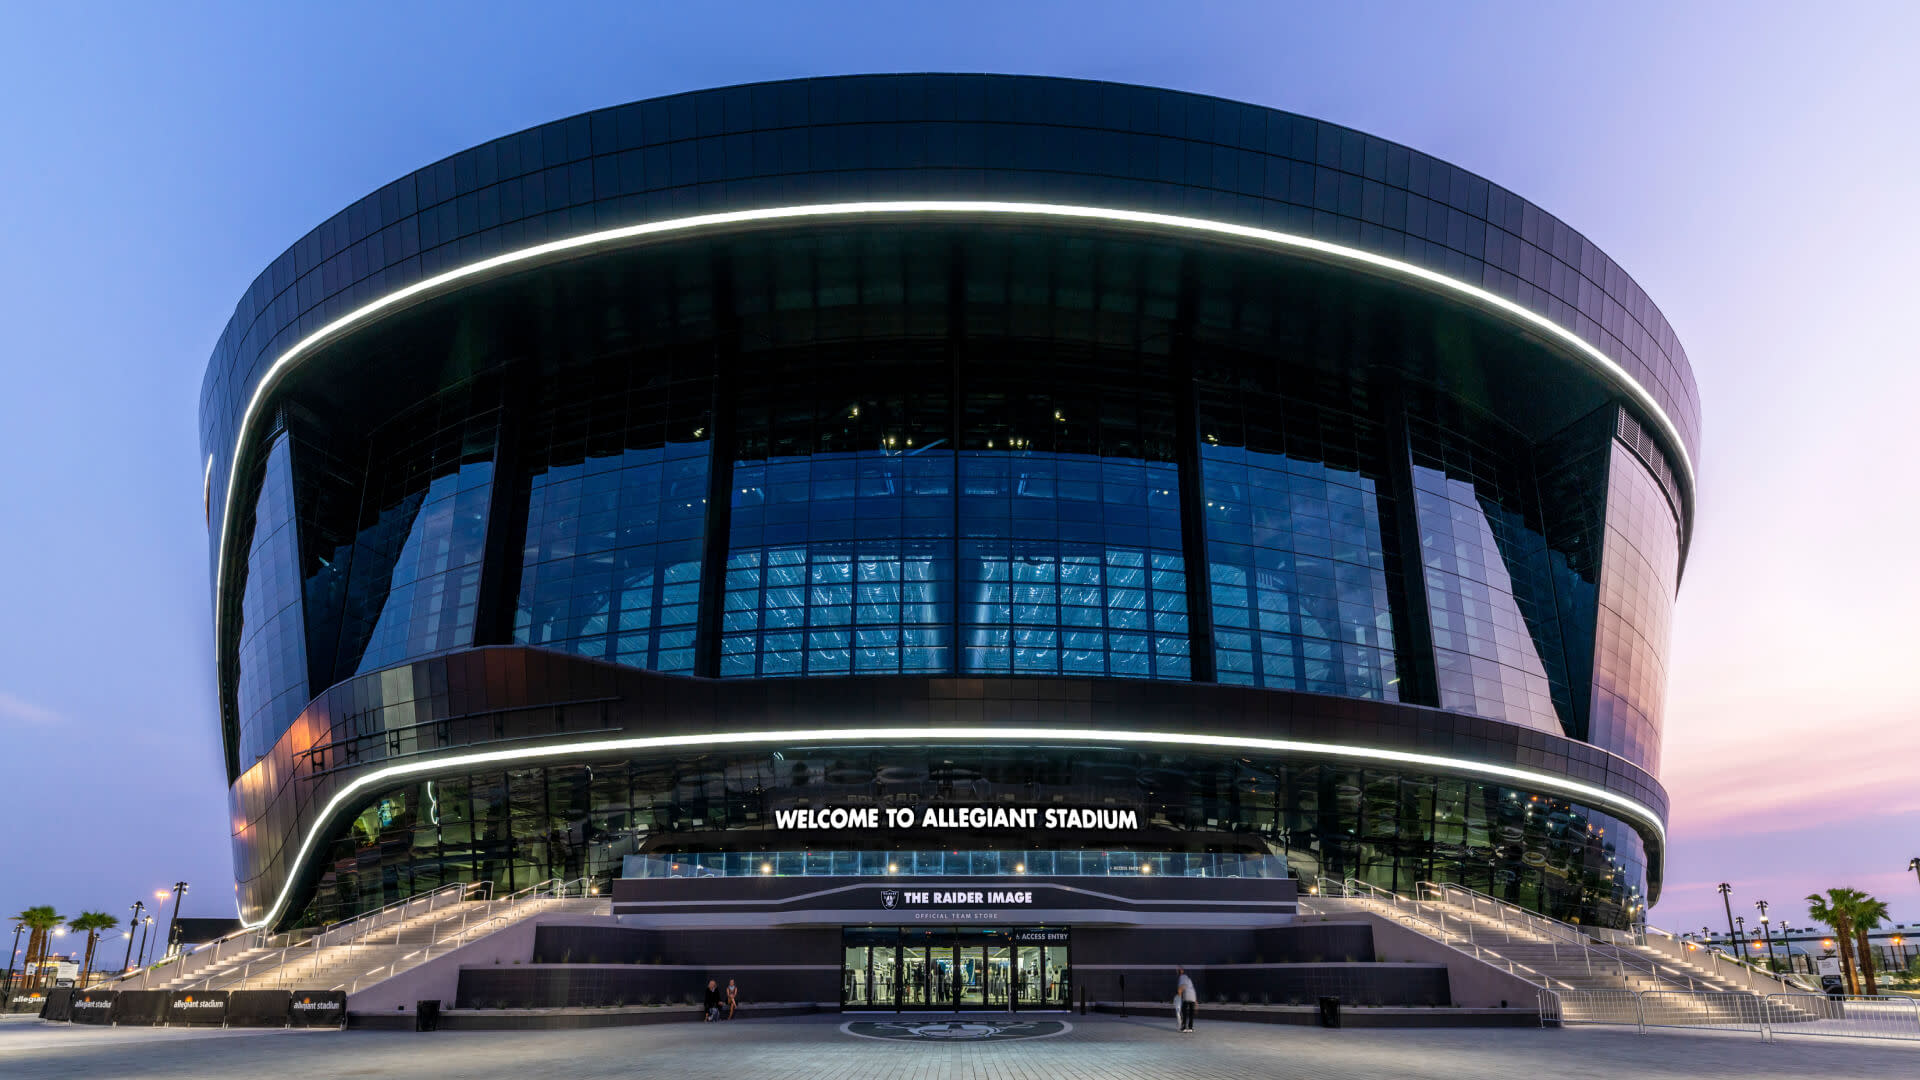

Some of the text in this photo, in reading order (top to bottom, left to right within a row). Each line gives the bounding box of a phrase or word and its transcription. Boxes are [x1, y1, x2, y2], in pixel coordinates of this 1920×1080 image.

[775, 806, 1138, 830] WELCOME TO ALLEGIANT STADIUM
[904, 892, 929, 904] THE
[933, 892, 984, 904] RAIDER
[988, 892, 1033, 904] IMAGE
[12, 996, 46, 1004] allegian
[173, 1000, 224, 1010] allegiant stadium
[317, 1000, 340, 1010] stadium
